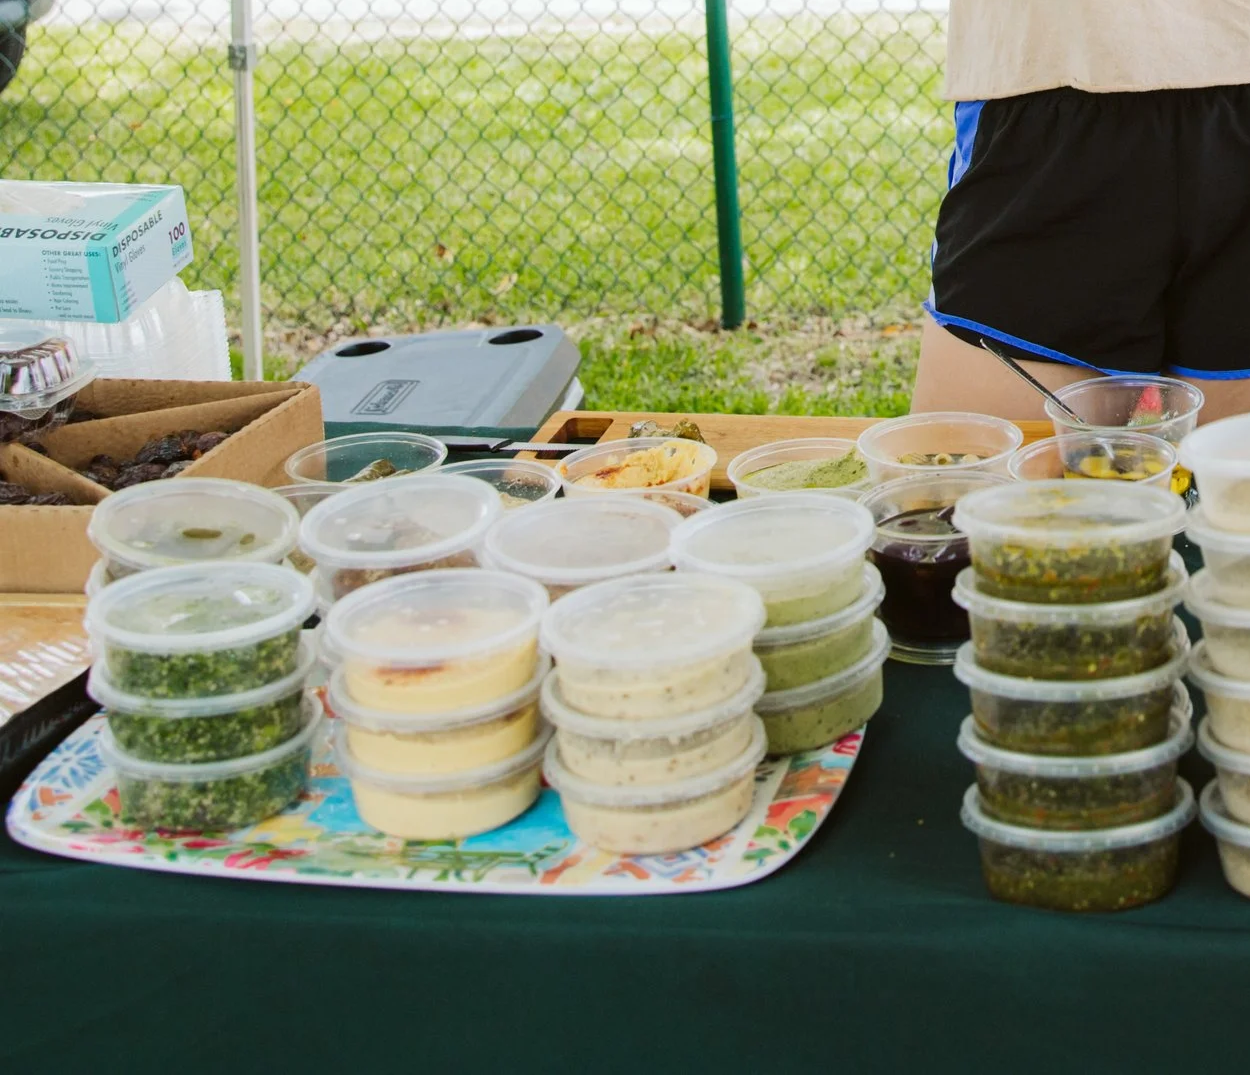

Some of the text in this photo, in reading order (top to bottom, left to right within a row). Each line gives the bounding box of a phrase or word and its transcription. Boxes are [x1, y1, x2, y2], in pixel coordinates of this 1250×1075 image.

[45, 216, 119, 231] Vinyl Gloves
[112, 209, 163, 258] DISPOSABLE
[168, 222, 185, 245] 100
[115, 244, 146, 274] Vinyl Gloves
